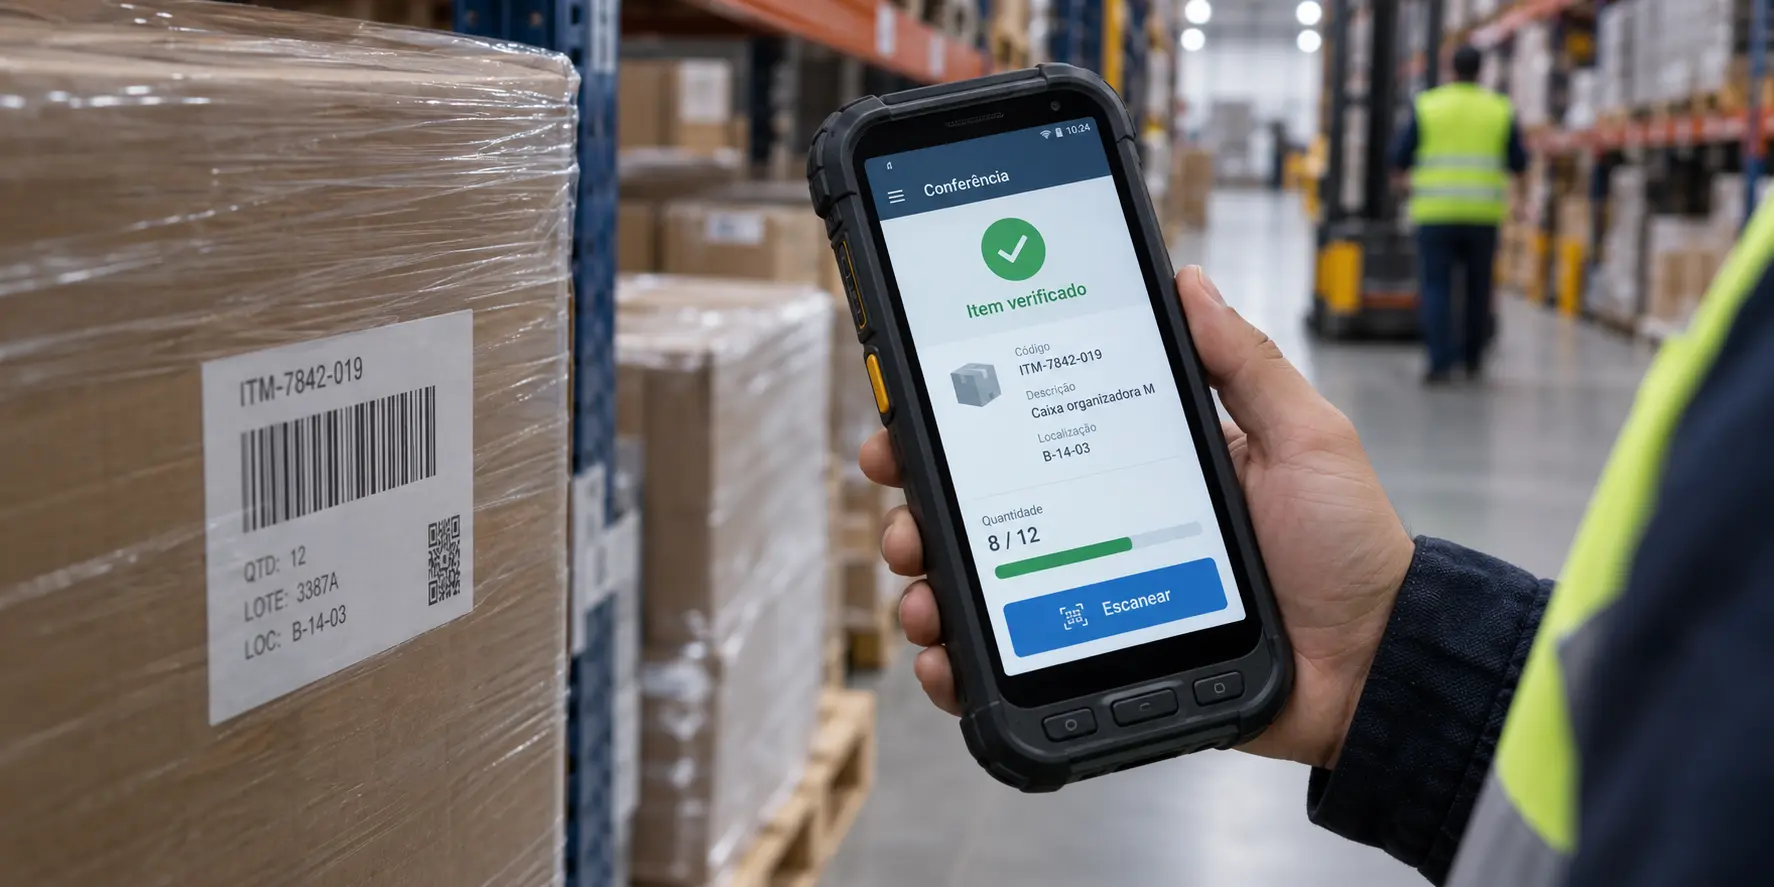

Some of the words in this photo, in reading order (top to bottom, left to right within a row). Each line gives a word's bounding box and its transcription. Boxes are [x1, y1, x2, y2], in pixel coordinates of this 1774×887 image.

[1065, 123, 1091, 136] 10:24
[924, 170, 1010, 197] Conferência
[966, 301, 1004, 318] Item
[1007, 283, 1087, 310] verificado
[1015, 343, 1050, 357] Código
[1019, 348, 1103, 376] ITM-7842-019
[240, 356, 363, 407] ITM-7842-019
[1026, 382, 1076, 401] Descrição
[1031, 404, 1065, 419] Caixa
[1067, 389, 1141, 412] organizadora
[1143, 383, 1155, 395] M
[1037, 423, 1097, 444] Localização
[1042, 442, 1091, 462] B-14-03
[981, 504, 1044, 527] Quantidade
[988, 535, 1000, 551] 8
[1017, 527, 1040, 545] 12
[244, 554, 280, 584] QTD:
[290, 545, 307, 569] 12
[244, 590, 289, 623] LOTE:
[296, 572, 339, 603] 3387A
[1102, 589, 1171, 616] Escanear
[245, 631, 281, 660] LOC:
[292, 605, 347, 643] B-14-03
